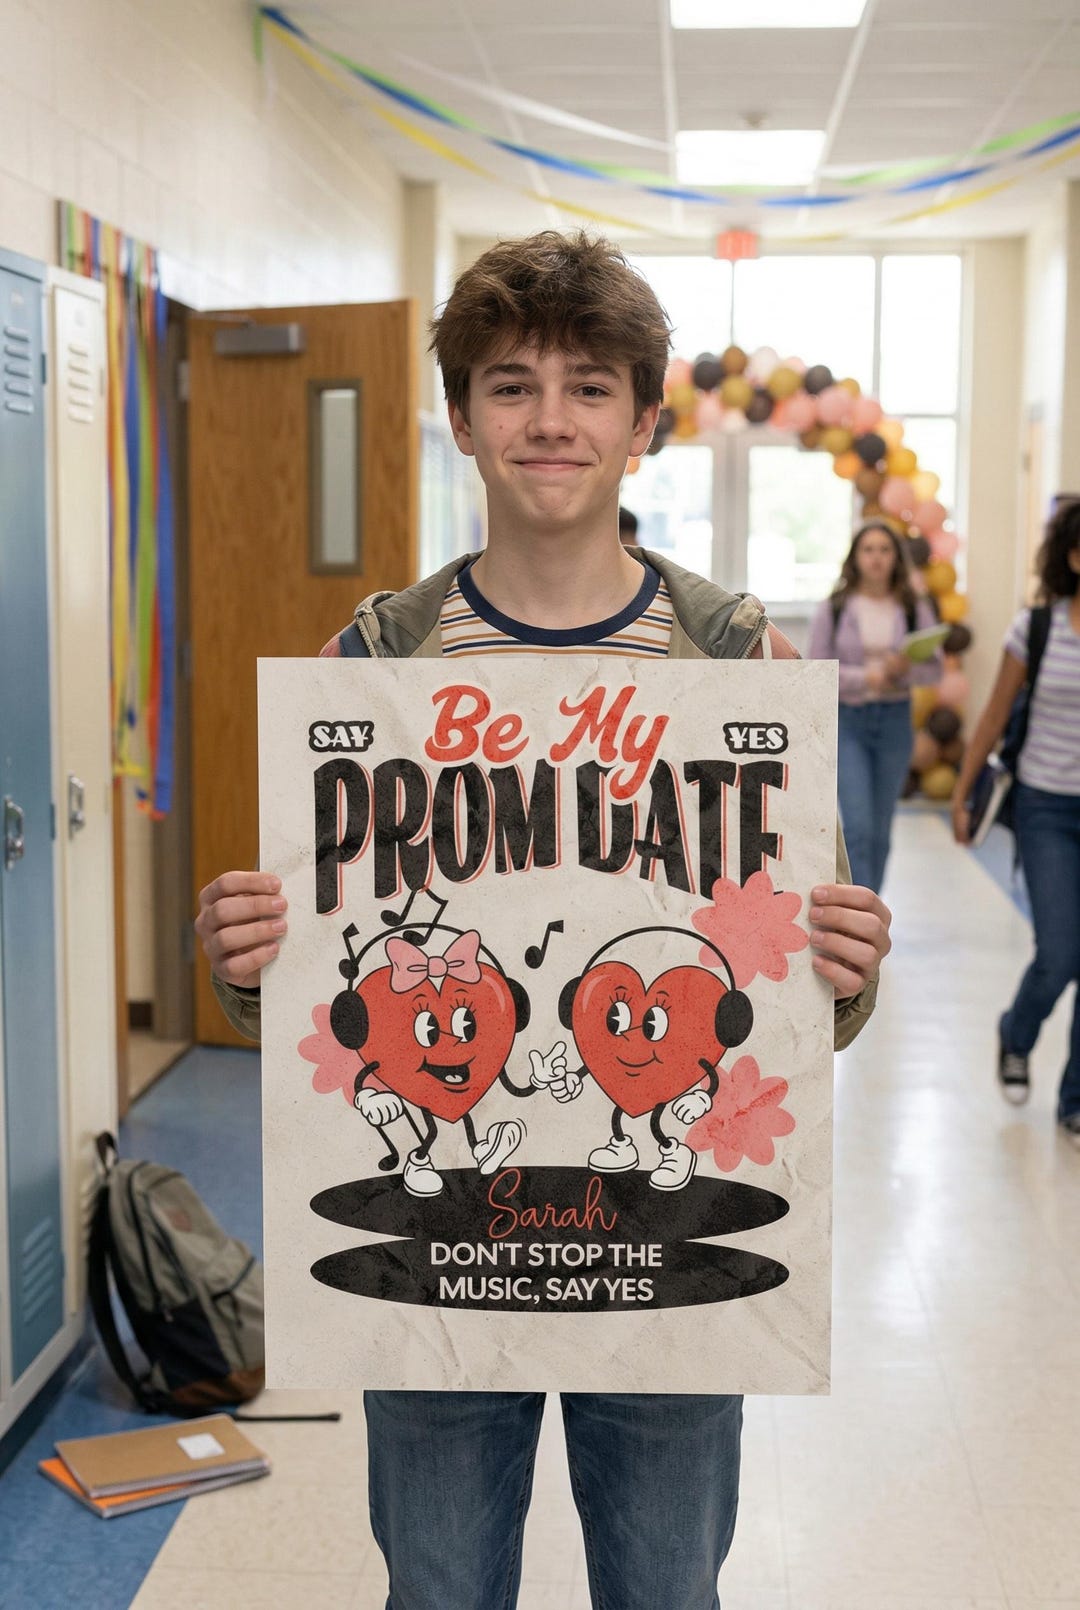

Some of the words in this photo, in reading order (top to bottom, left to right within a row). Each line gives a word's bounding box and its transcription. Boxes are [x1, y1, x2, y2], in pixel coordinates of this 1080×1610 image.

[312, 723, 371, 749] SAY
[425, 684, 530, 763] Be
[549, 685, 669, 800] My
[726, 724, 785, 750] YES
[313, 757, 561, 916] PROM
[575, 758, 789, 901] DATE
[487, 1167, 618, 1239] Sarah
[429, 1242, 523, 1267] DON'T
[527, 1242, 604, 1267] STOP
[607, 1243, 664, 1267] THE
[438, 1276, 541, 1305] MUSIC,
[545, 1276, 600, 1302] SAY
[602, 1277, 655, 1302] YES
